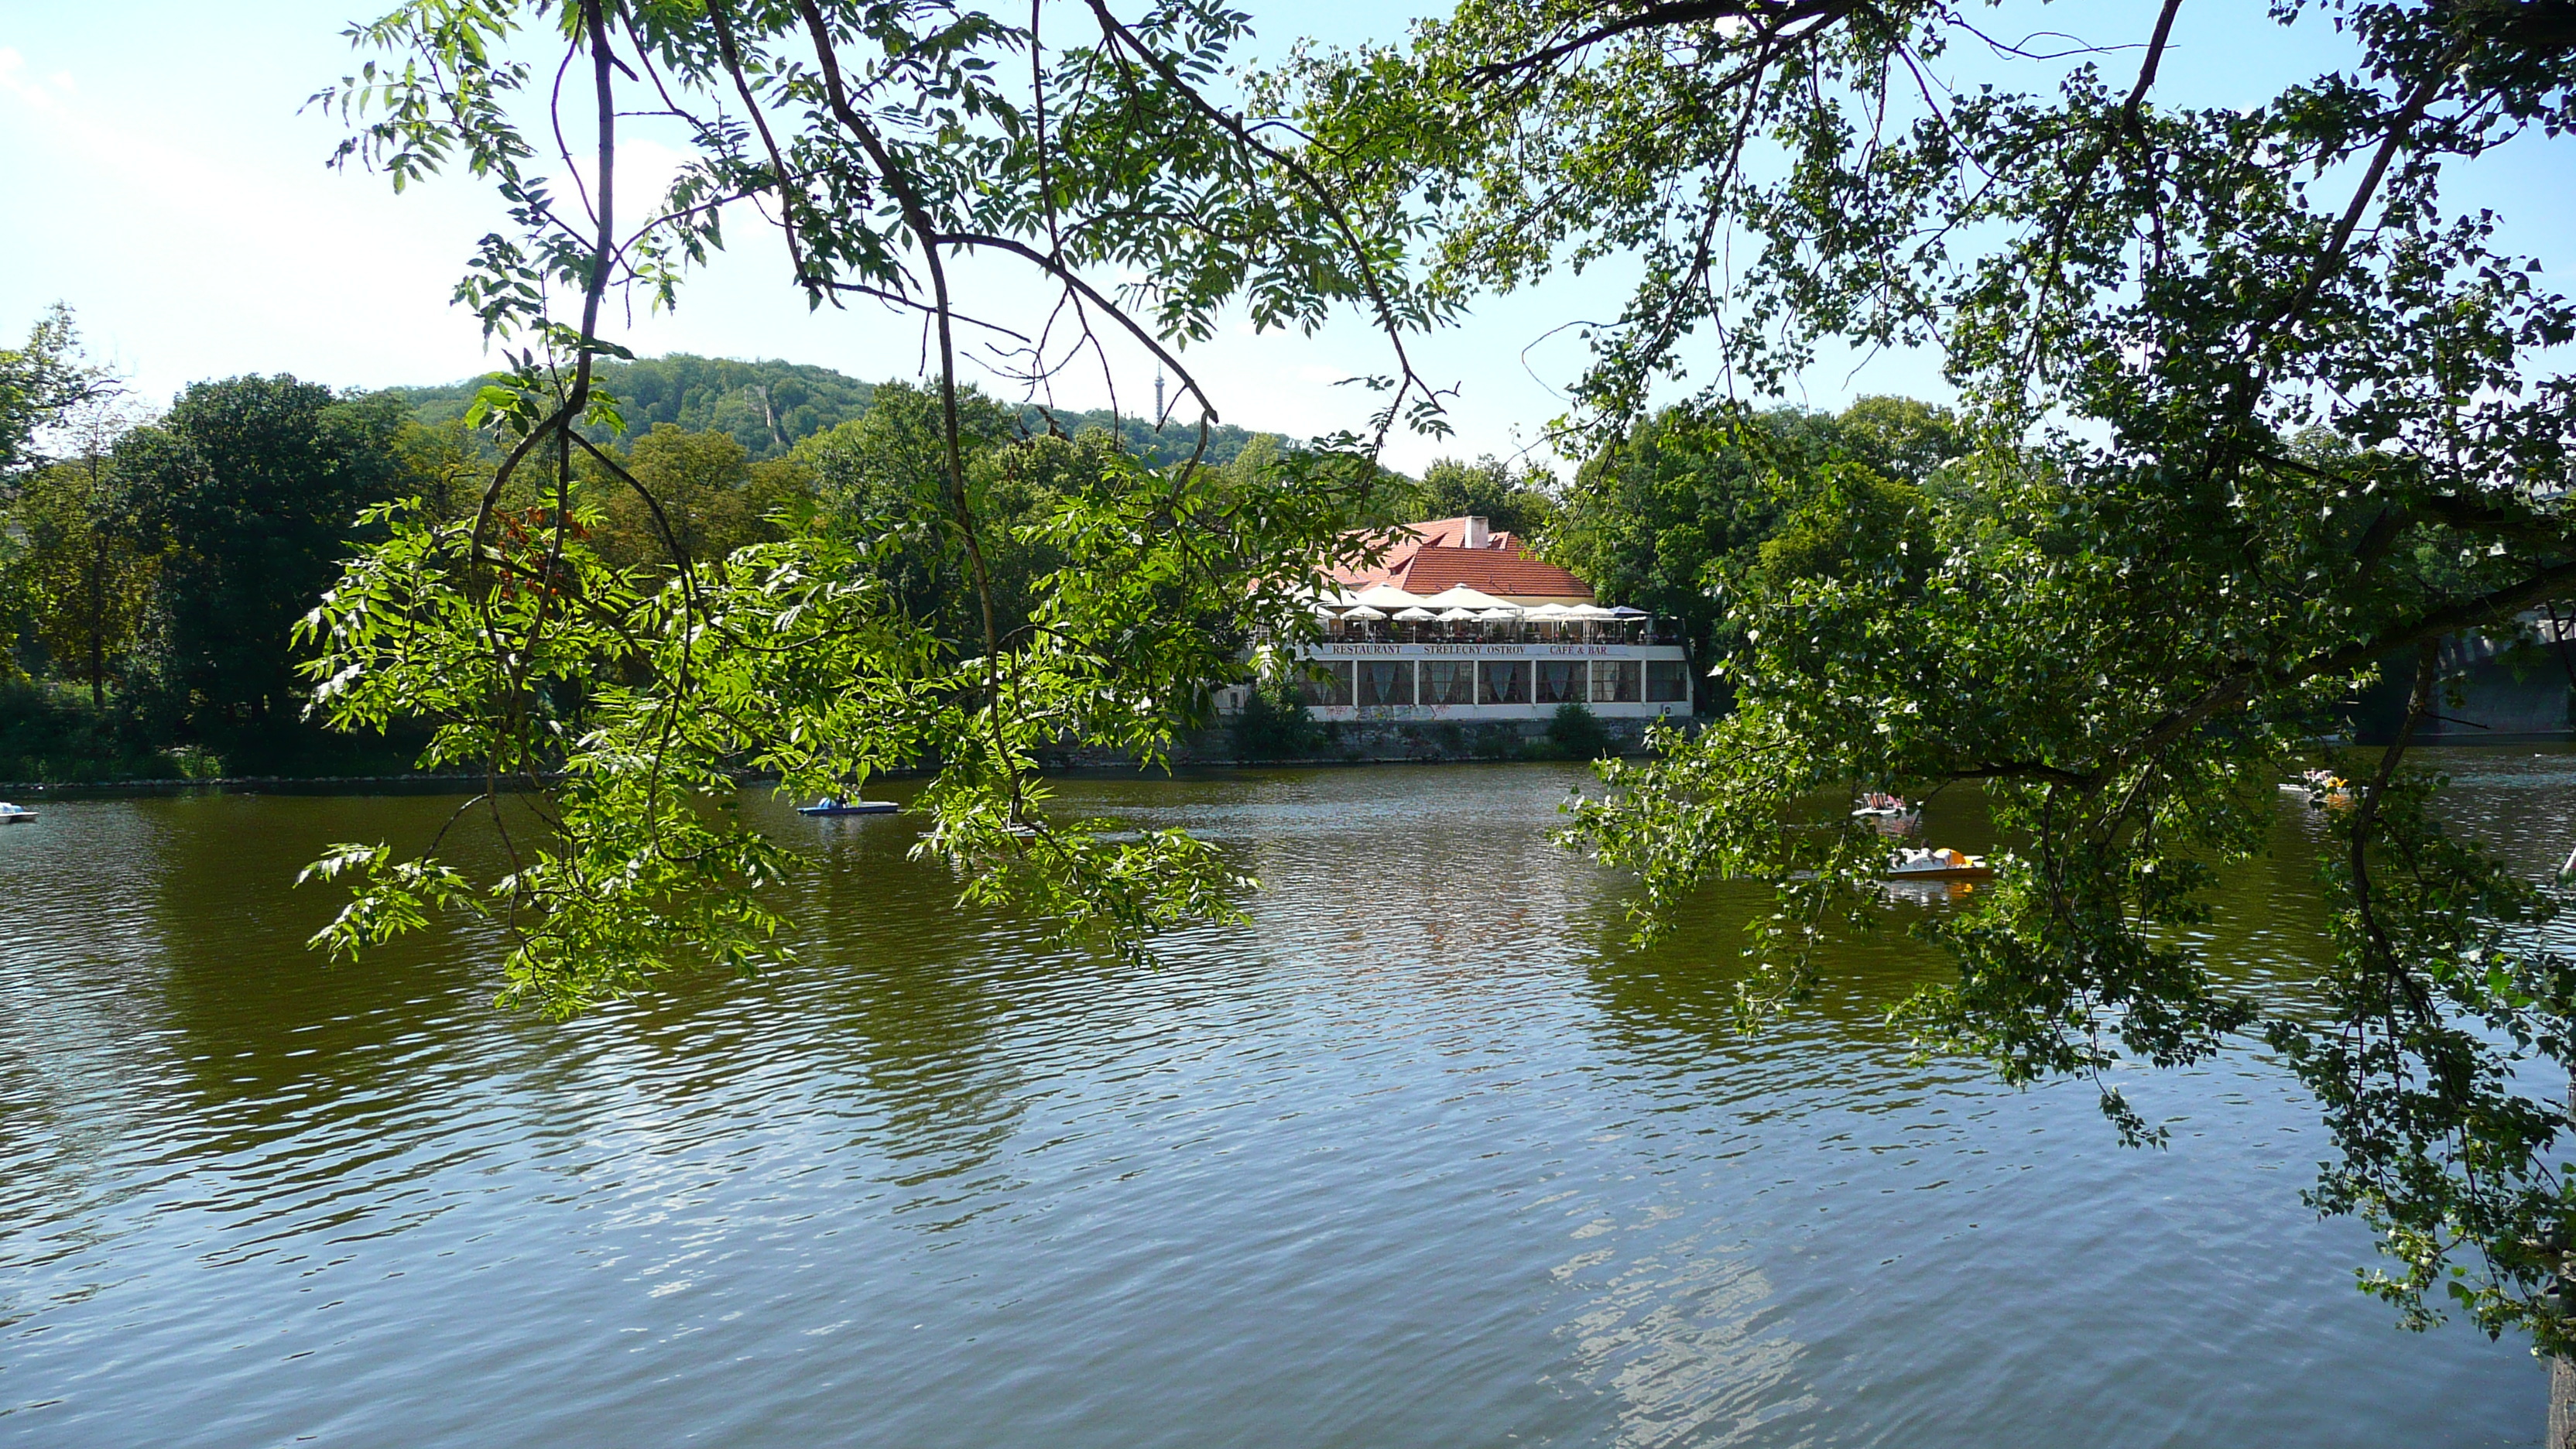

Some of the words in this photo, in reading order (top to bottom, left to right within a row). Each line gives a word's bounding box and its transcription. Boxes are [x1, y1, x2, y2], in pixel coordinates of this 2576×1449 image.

[1333, 645, 1402, 655] RESTAURANT
[1487, 645, 1526, 655] OSTROV
[1577, 646, 1585, 655] &
[1588, 646, 1608, 656] BAR
